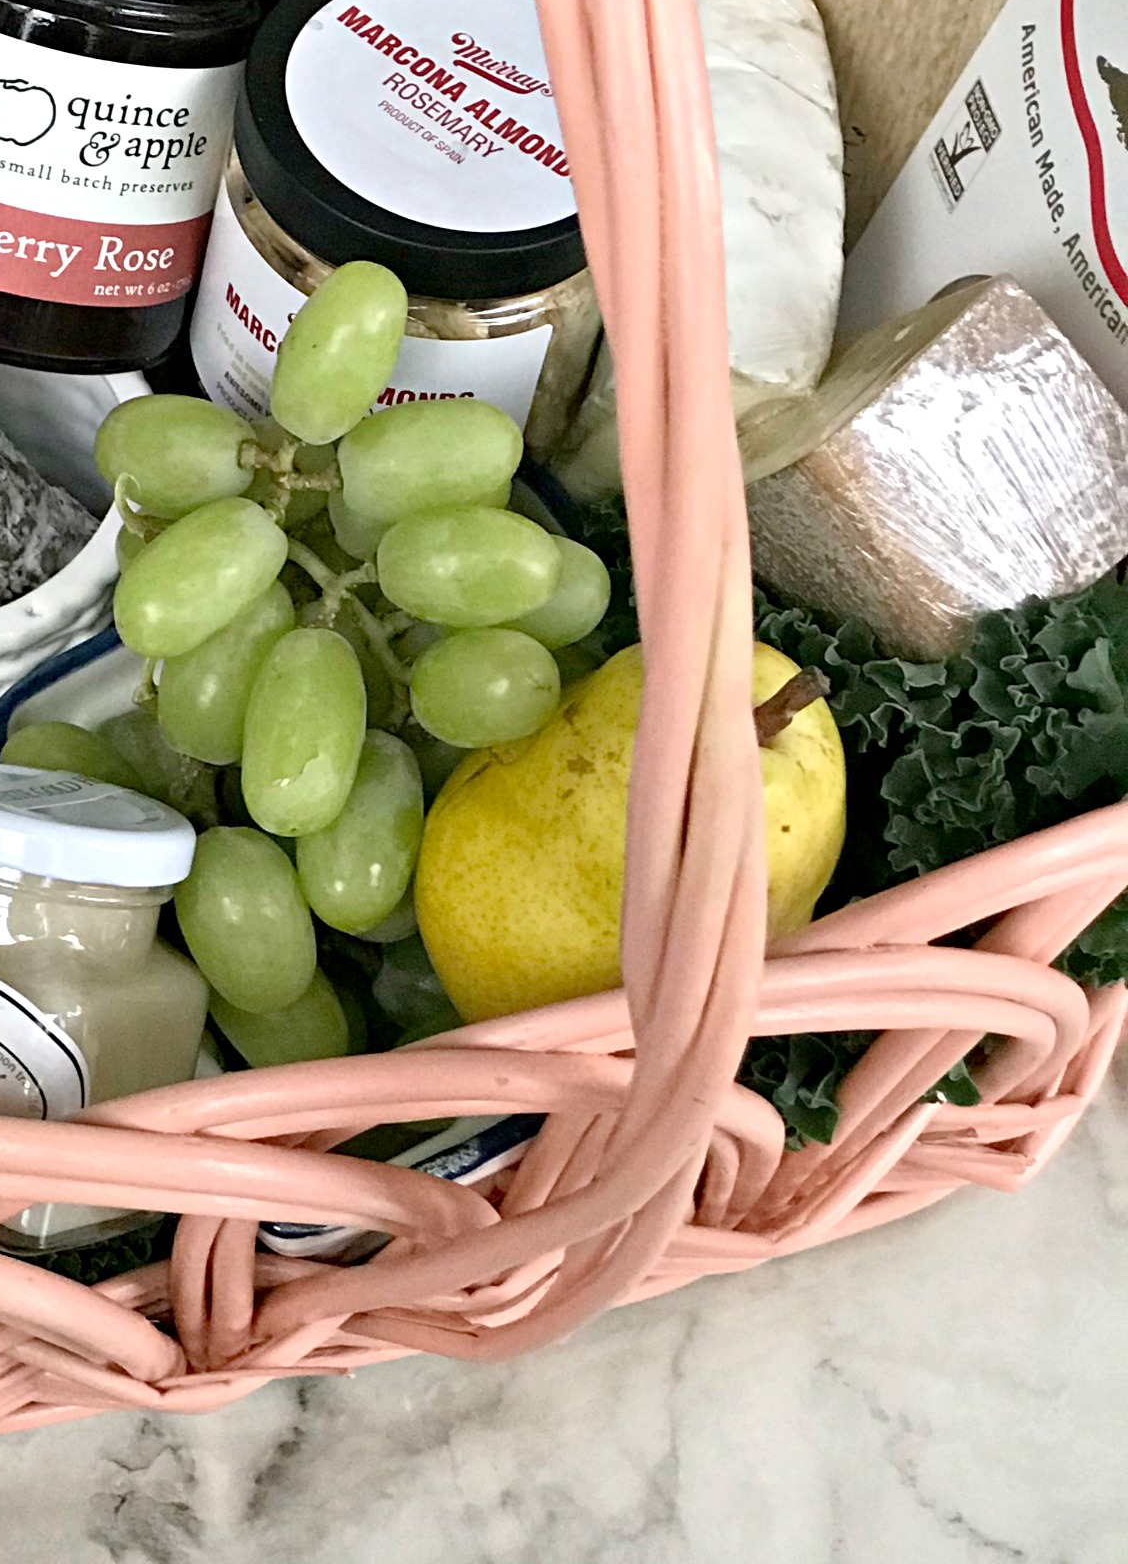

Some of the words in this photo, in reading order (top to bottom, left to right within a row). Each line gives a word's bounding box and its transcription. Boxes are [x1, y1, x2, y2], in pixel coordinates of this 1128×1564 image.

[336, 5, 468, 102] MARCONA
[66, 94, 190, 130] quince
[377, 99, 425, 134] PRODUCT
[421, 131, 438, 144] OF
[434, 139, 466, 165] SPAIN
[382, 71, 504, 158] ROSEMARY
[1021, 23, 1044, 148] American
[1035, 149, 1065, 234] Made,
[78, 131, 121, 166] &
[123, 132, 207, 170] apple
[60, 169, 113, 191] batch
[119, 178, 194, 196] preserves
[93, 235, 175, 273] Rose
[94, 283, 121, 297] net
[124, 282, 144, 297] wt
[147, 281, 155, 296] 6
[226, 282, 282, 354] MARC
